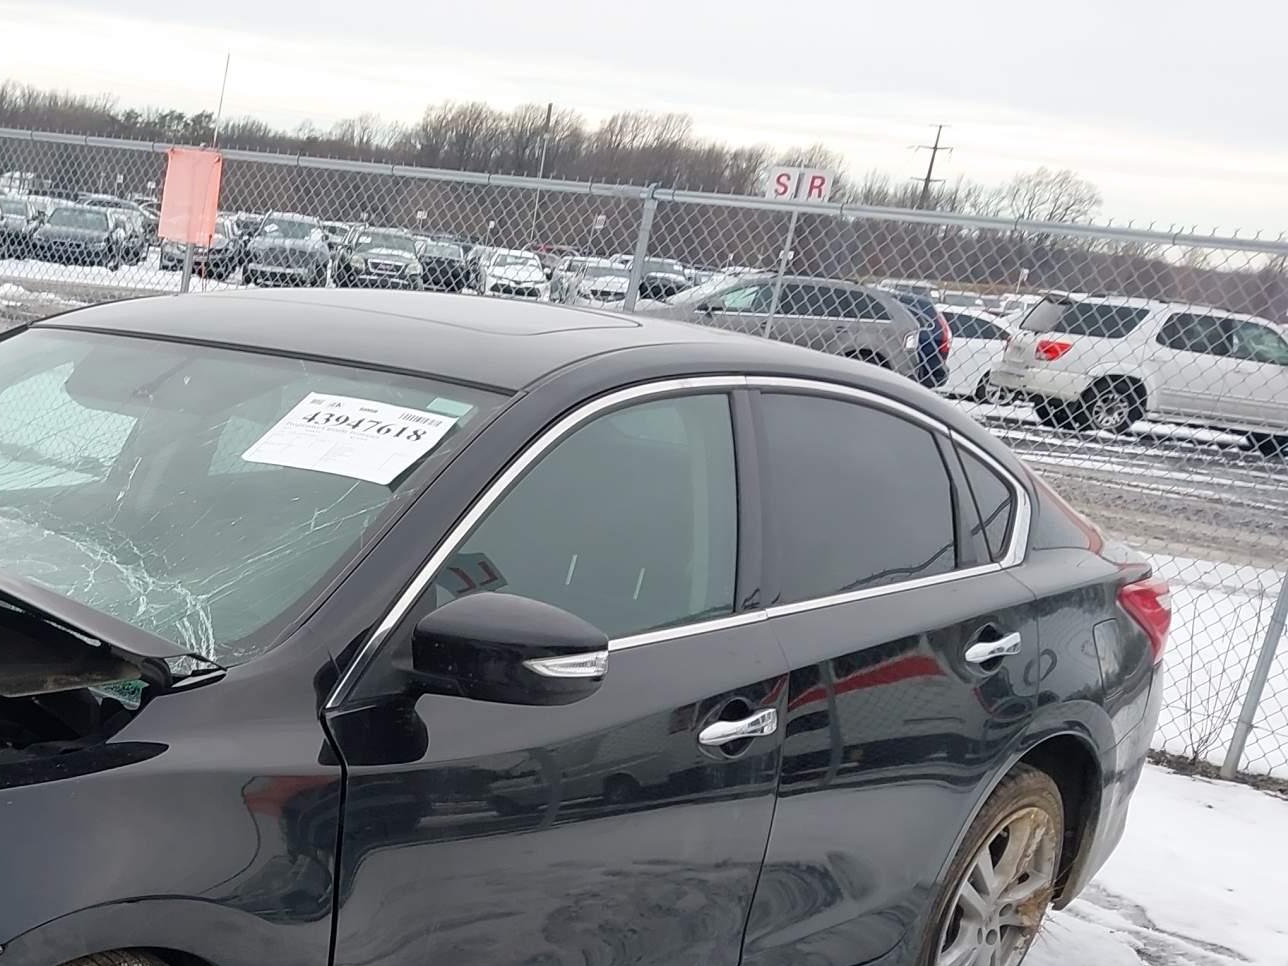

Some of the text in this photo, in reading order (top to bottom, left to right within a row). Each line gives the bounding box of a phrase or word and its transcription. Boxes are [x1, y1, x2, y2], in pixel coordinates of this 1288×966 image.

[774, 172, 826, 199] S R
[301, 410, 428, 442] 43947618
